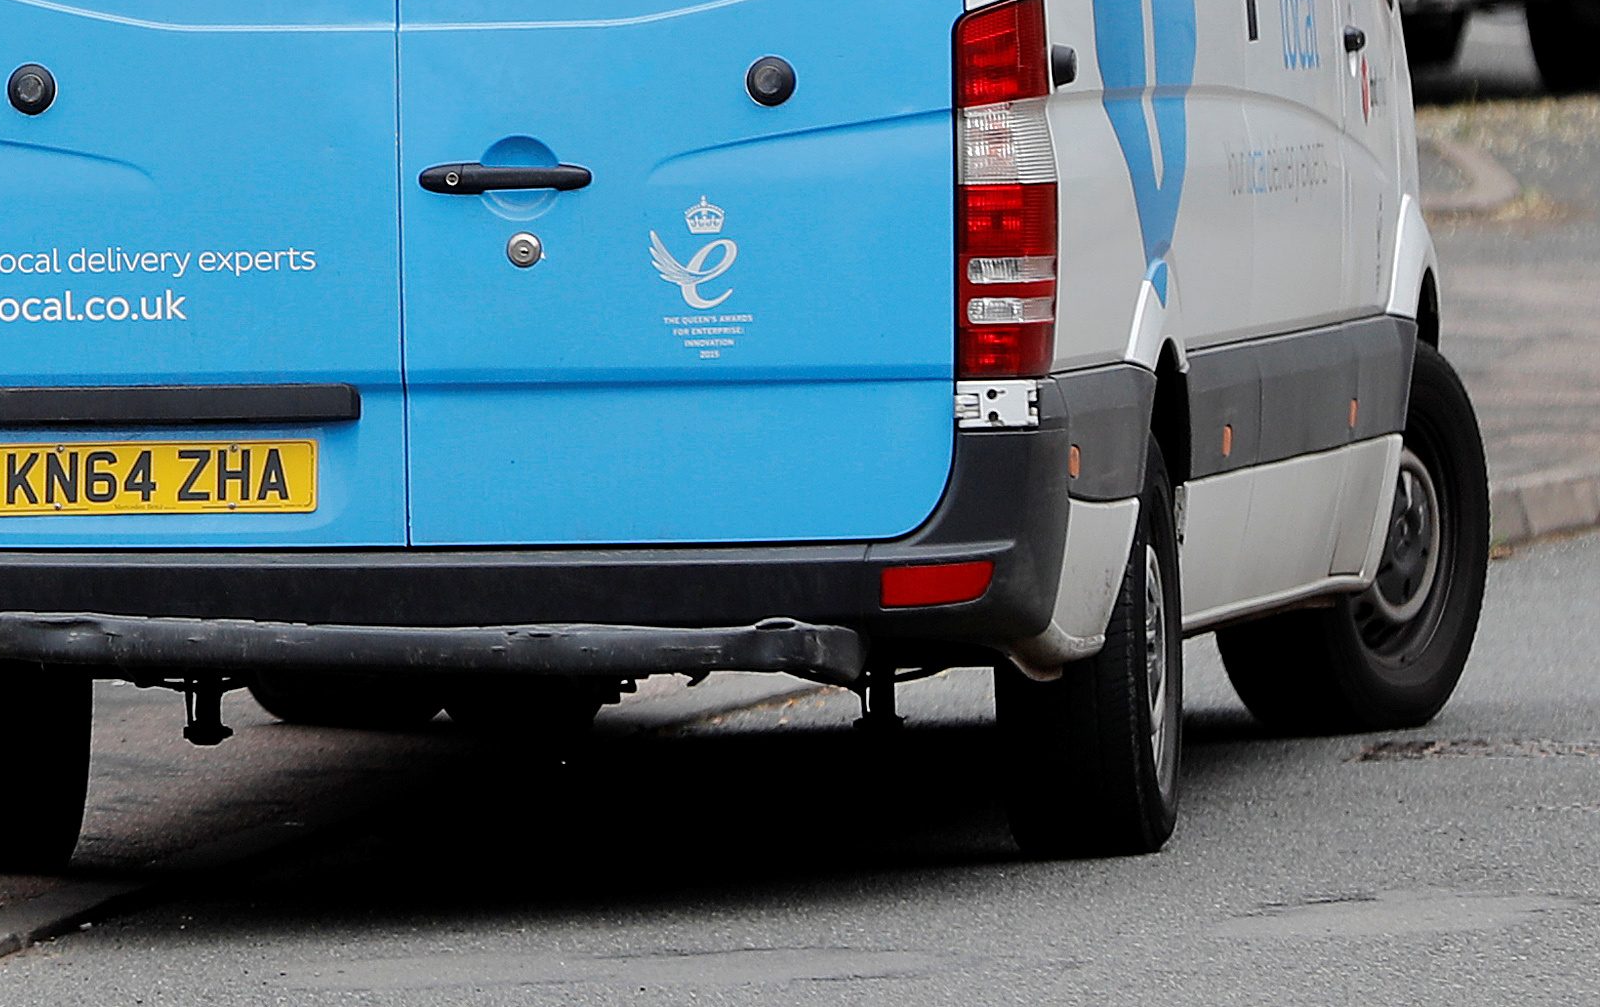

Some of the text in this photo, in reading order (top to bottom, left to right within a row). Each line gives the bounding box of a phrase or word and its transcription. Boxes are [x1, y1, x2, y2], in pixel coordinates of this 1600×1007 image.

[68, 247, 190, 277] delivery
[198, 246, 316, 276] experts
[664, 316, 680, 324] THE
[672, 327, 690, 335] FOR
[684, 339, 735, 348] INNOVATION
[6, 448, 289, 505] KN64 ZHA
